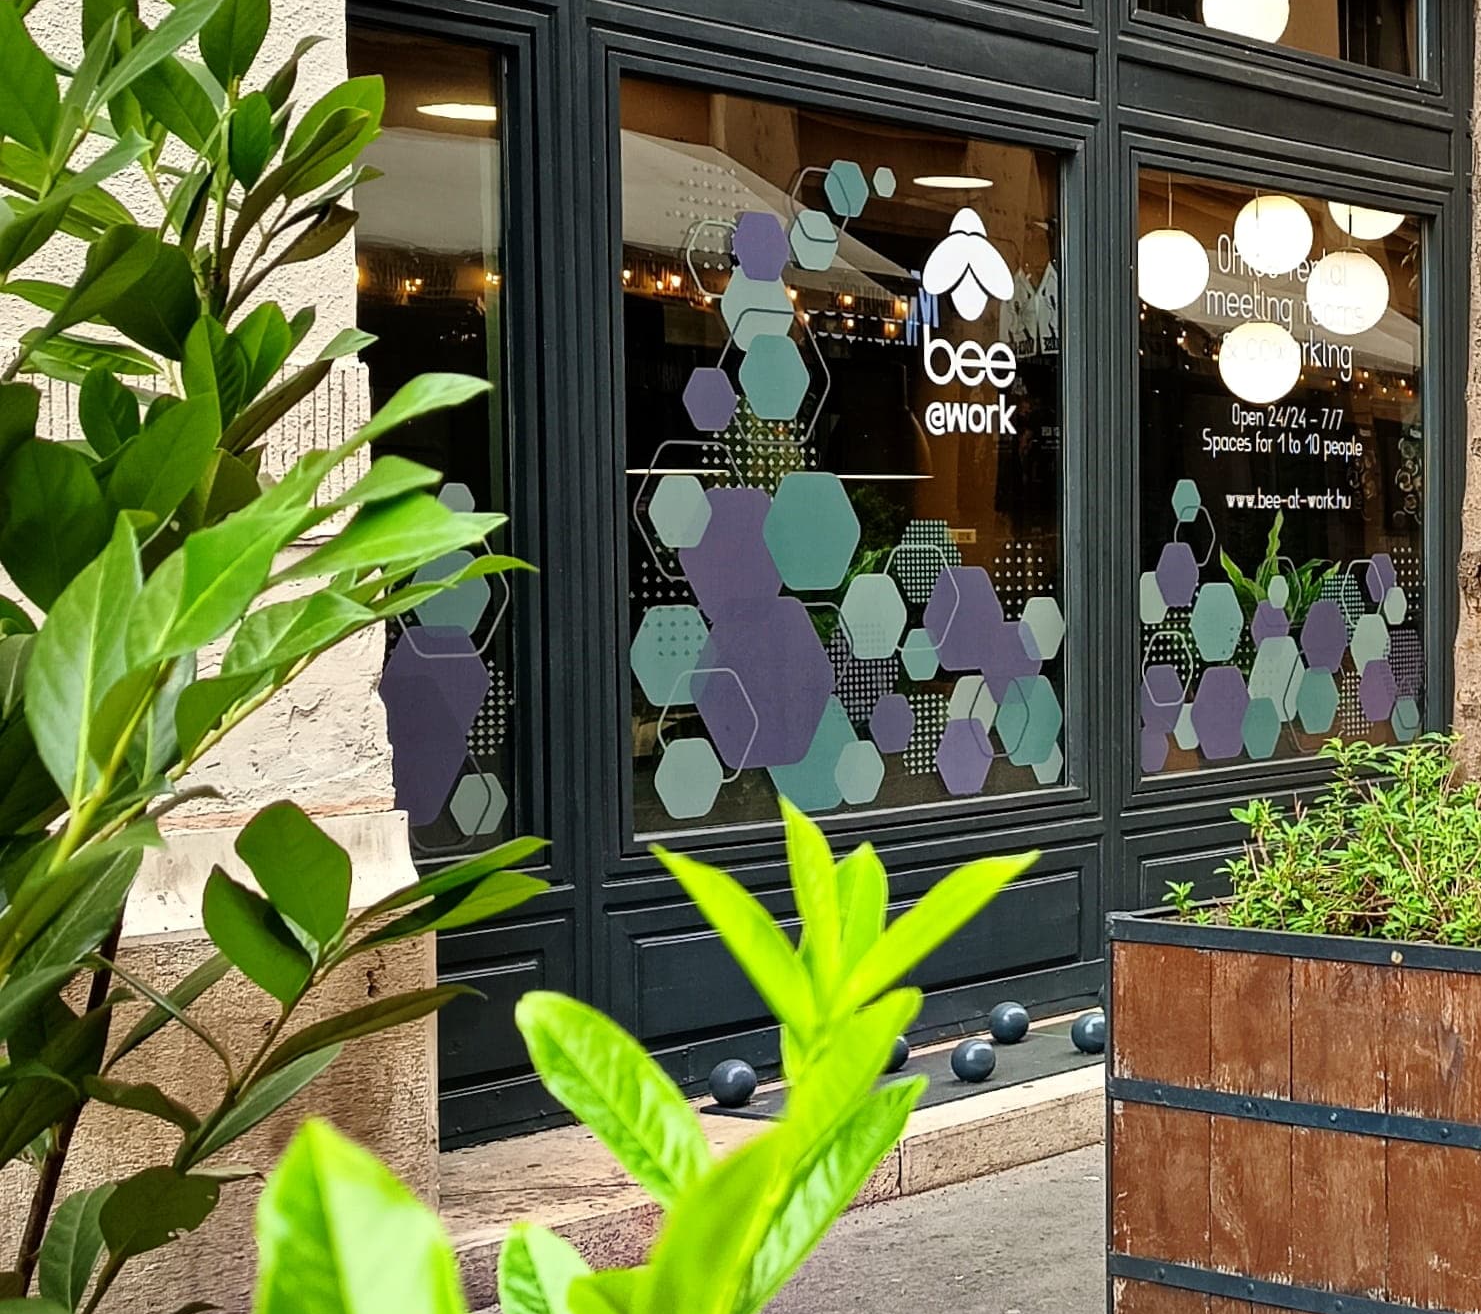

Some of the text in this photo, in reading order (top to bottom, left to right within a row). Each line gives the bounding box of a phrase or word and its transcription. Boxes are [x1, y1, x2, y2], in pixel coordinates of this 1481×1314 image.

[1205, 281, 1293, 333] meeting
[923, 323, 1017, 389] bee
[925, 393, 1017, 436] @work
[1231, 403, 1264, 433] Open
[1268, 405, 1306, 429] 24/24
[1321, 408, 1344, 430] 7/7
[1202, 428, 1363, 463] Spaces for 1 to 10 people
[1225, 486, 1351, 509] www.bee-at-work.hu
